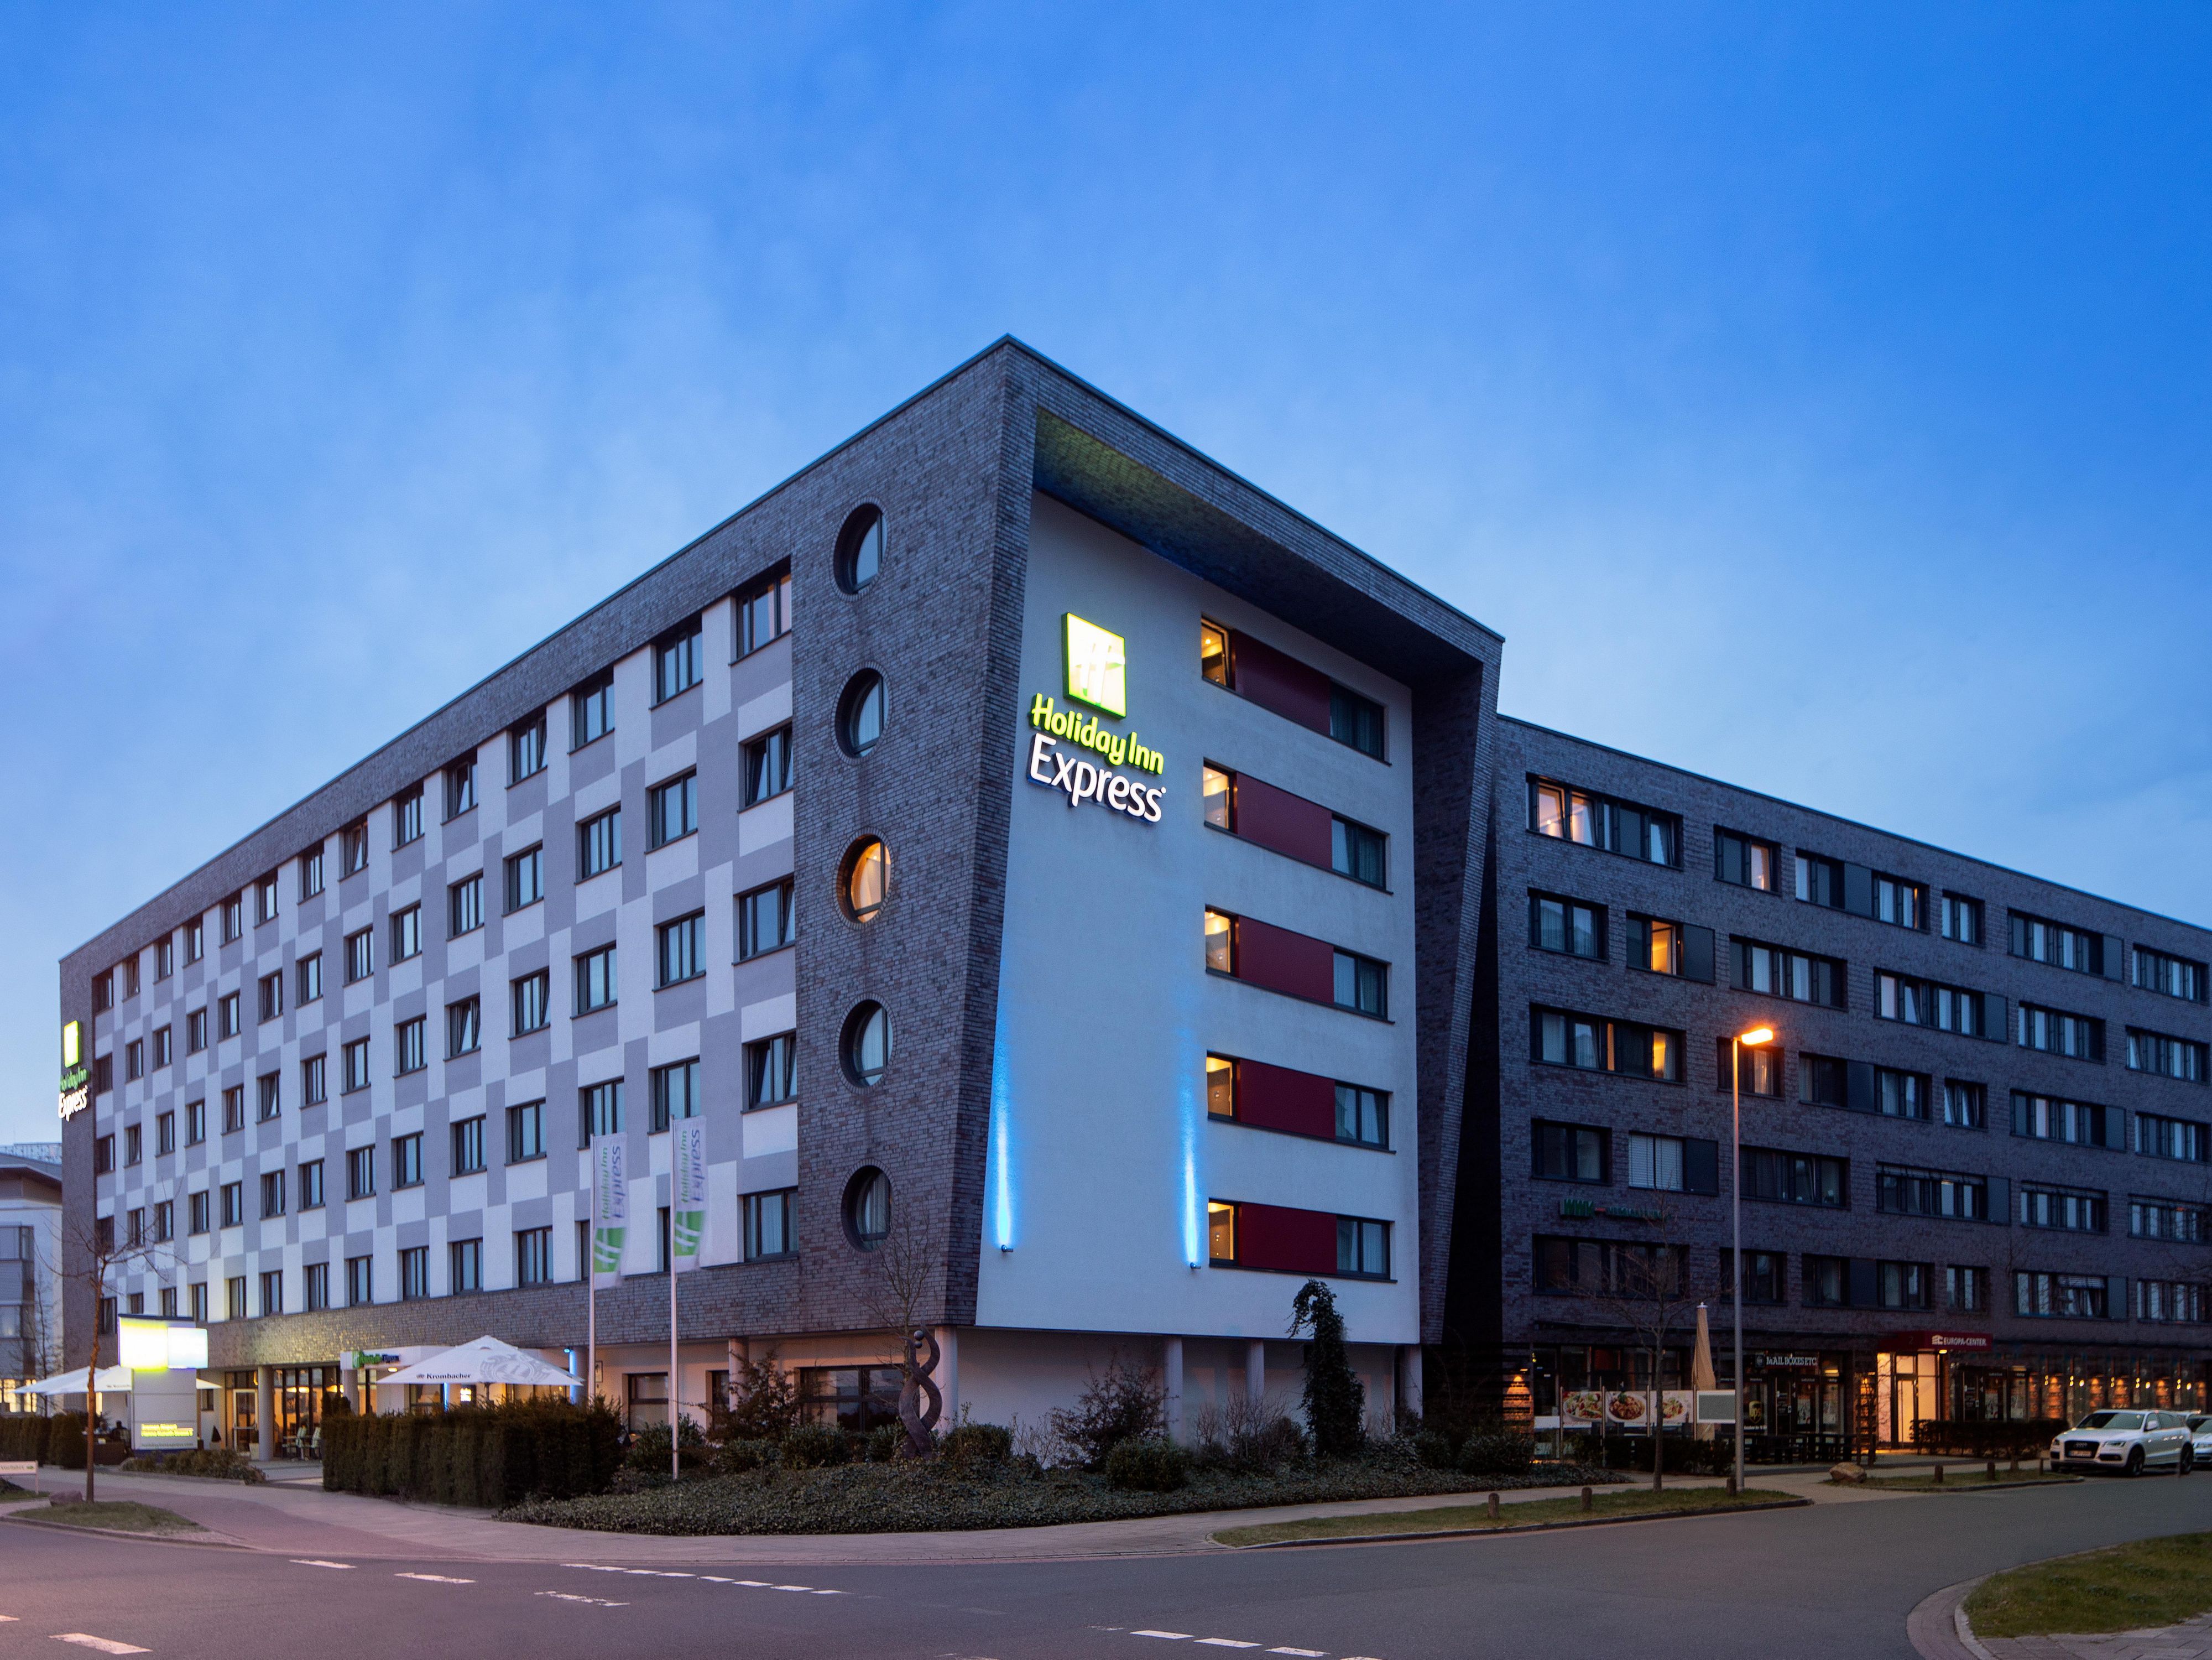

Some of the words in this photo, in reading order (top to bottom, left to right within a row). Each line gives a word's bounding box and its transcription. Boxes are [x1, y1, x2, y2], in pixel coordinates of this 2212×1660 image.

[1031, 693, 1126, 766] Holiday
[1128, 731, 1164, 775] Inn
[1029, 732, 1162, 823] Express
[58, 1087, 87, 1122] Express
[60, 1070, 78, 1092] Holiday
[612, 1144, 625, 1218] Express
[691, 1129, 705, 1201] Express
[1766, 1356, 1784, 1365] MAIL
[1785, 1356, 1804, 1366] BOXES
[1944, 1337, 1986, 1346] EUROPA-CENTER
